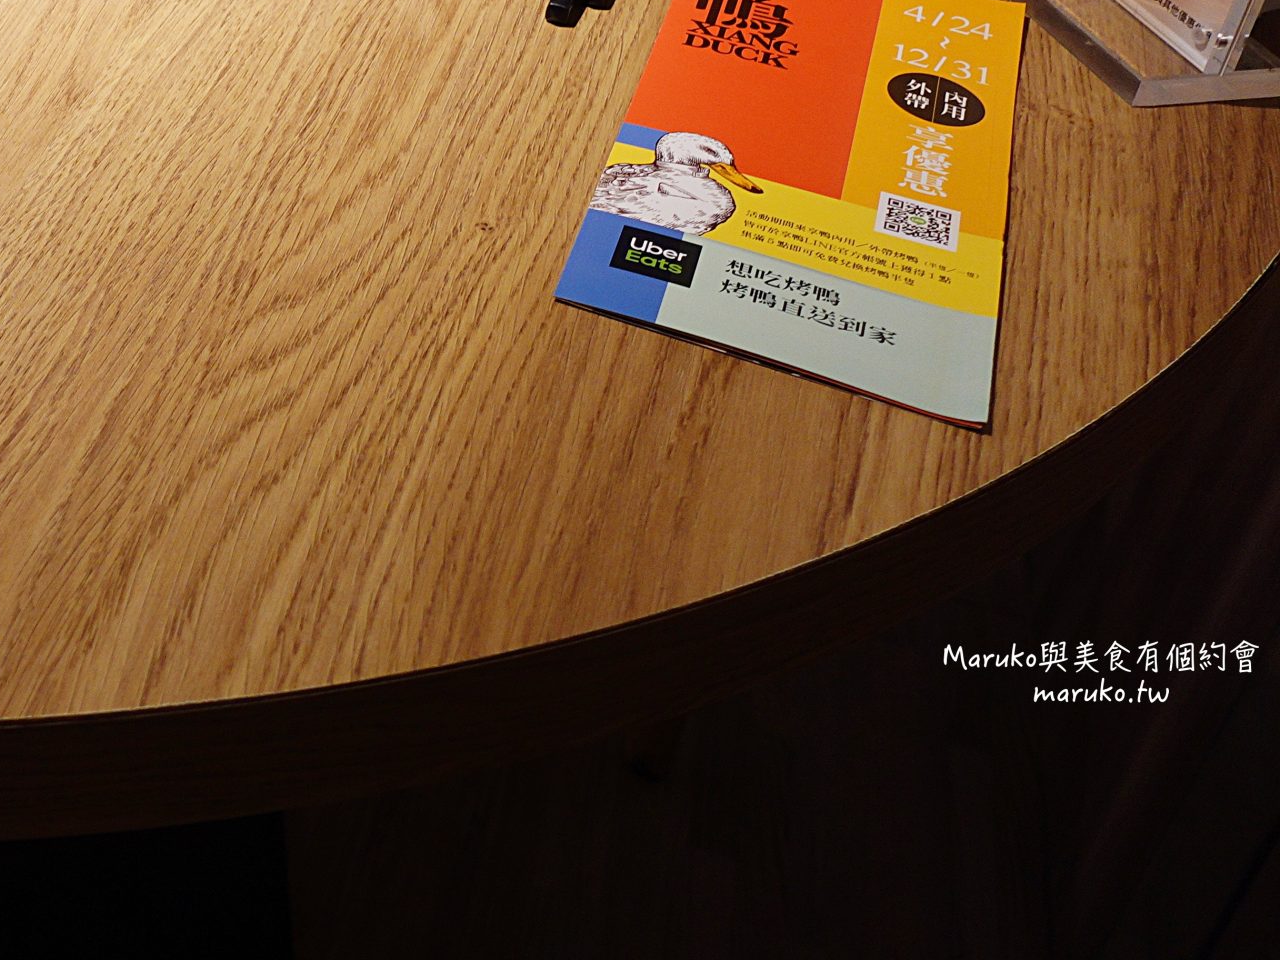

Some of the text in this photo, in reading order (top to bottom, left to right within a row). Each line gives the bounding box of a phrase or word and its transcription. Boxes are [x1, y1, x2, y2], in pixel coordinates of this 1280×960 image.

[687, 19, 800, 56] XIANG
[903, 5, 993, 40] 4/24
[681, 32, 789, 70] DUCK
[894, 43, 990, 86] 12/31
[897, 123, 954, 198] 享優惠
[625, 250, 683, 275] Eats
[630, 237, 687, 262] Uber
[726, 259, 841, 308] 想吃烤鴨
[719, 279, 898, 347] 烤鴨直送到家
